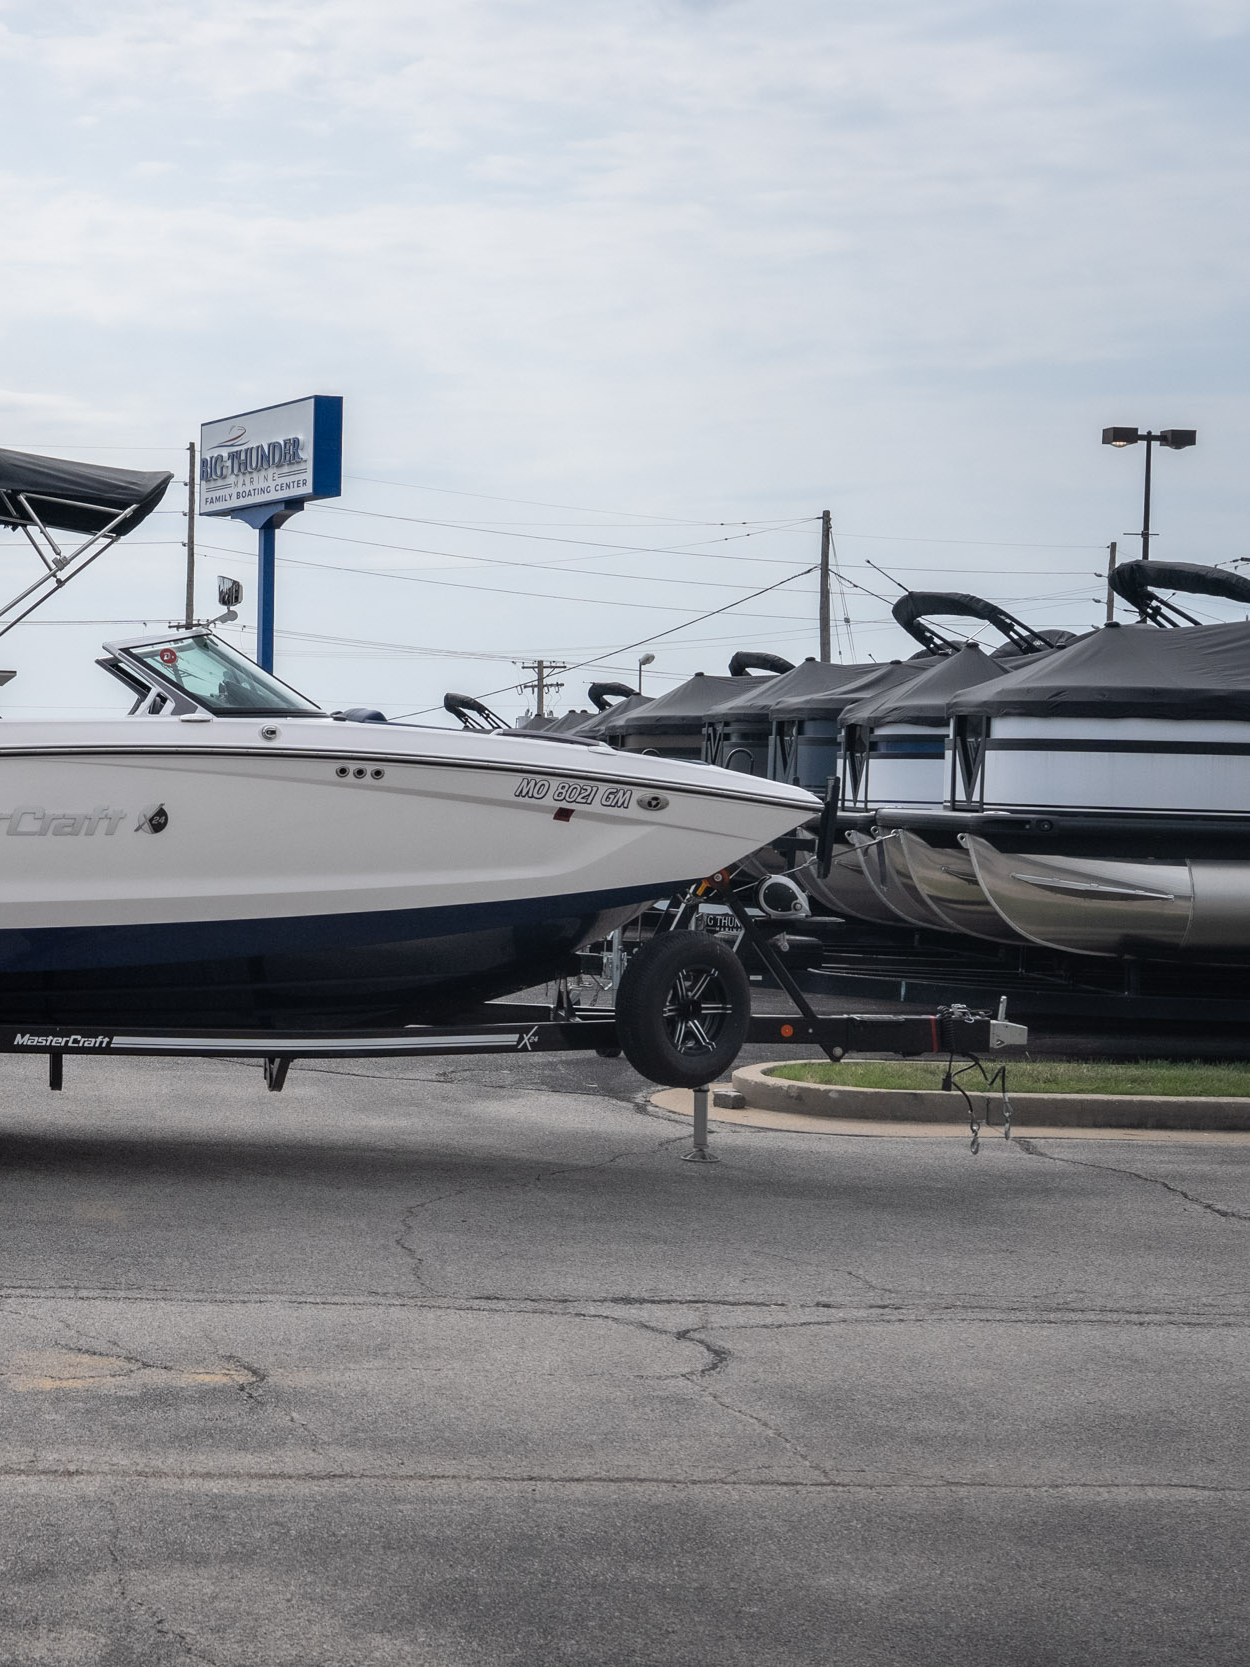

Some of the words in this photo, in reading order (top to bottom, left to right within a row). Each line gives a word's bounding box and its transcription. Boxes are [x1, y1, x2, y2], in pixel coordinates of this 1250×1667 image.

[200, 454, 224, 481] BIG
[228, 436, 303, 475] THUNDER
[205, 493, 233, 506] FAMILY
[236, 485, 271, 500] BOATING
[274, 478, 308, 492] CENTER
[233, 472, 277, 489] MARINE
[514, 778, 550, 799] MO
[553, 782, 599, 805] 8021
[601, 787, 633, 809] GM
[14, 1033, 110, 1047] MasterCraft
